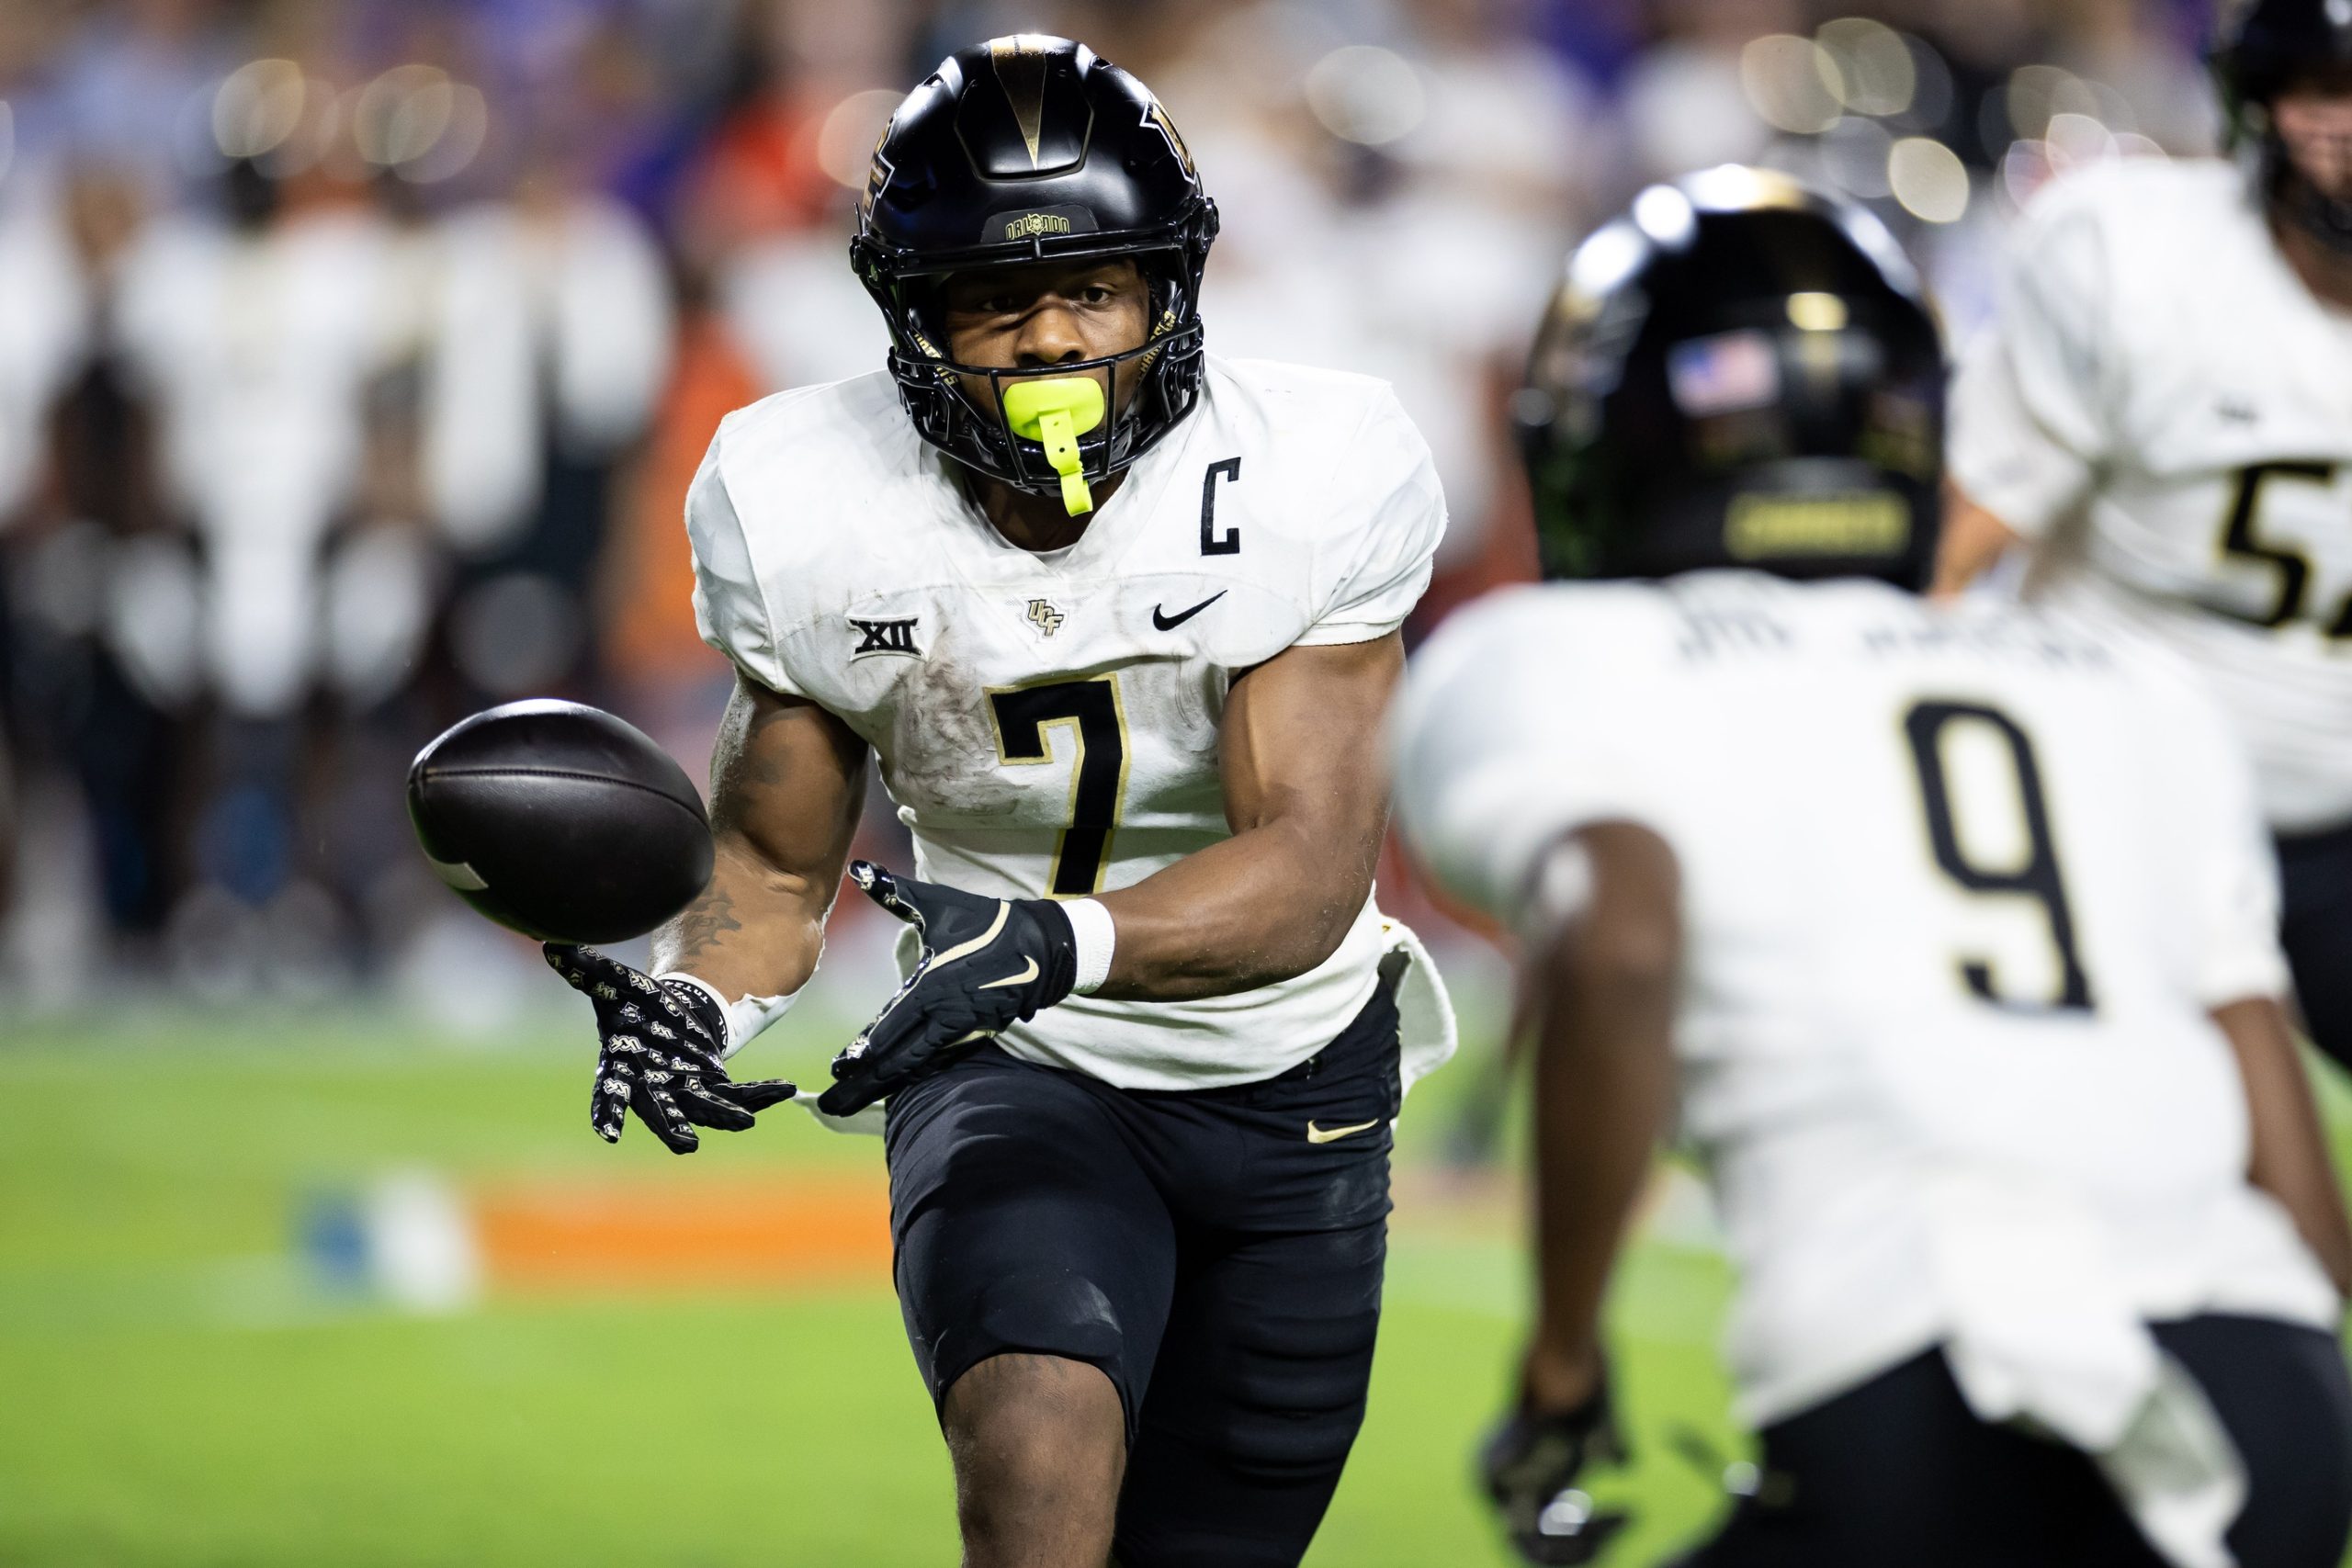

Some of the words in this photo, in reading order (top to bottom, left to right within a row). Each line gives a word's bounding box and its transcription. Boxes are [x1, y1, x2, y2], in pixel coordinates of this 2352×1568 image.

[1201, 457, 1241, 556] C
[2215, 457, 2352, 648] 5
[849, 618, 922, 656] XII
[1028, 599, 1064, 637] UCF
[983, 672, 1130, 899] 7
[1898, 696, 2097, 1016] 9
[608, 1034, 647, 1054] UCF
